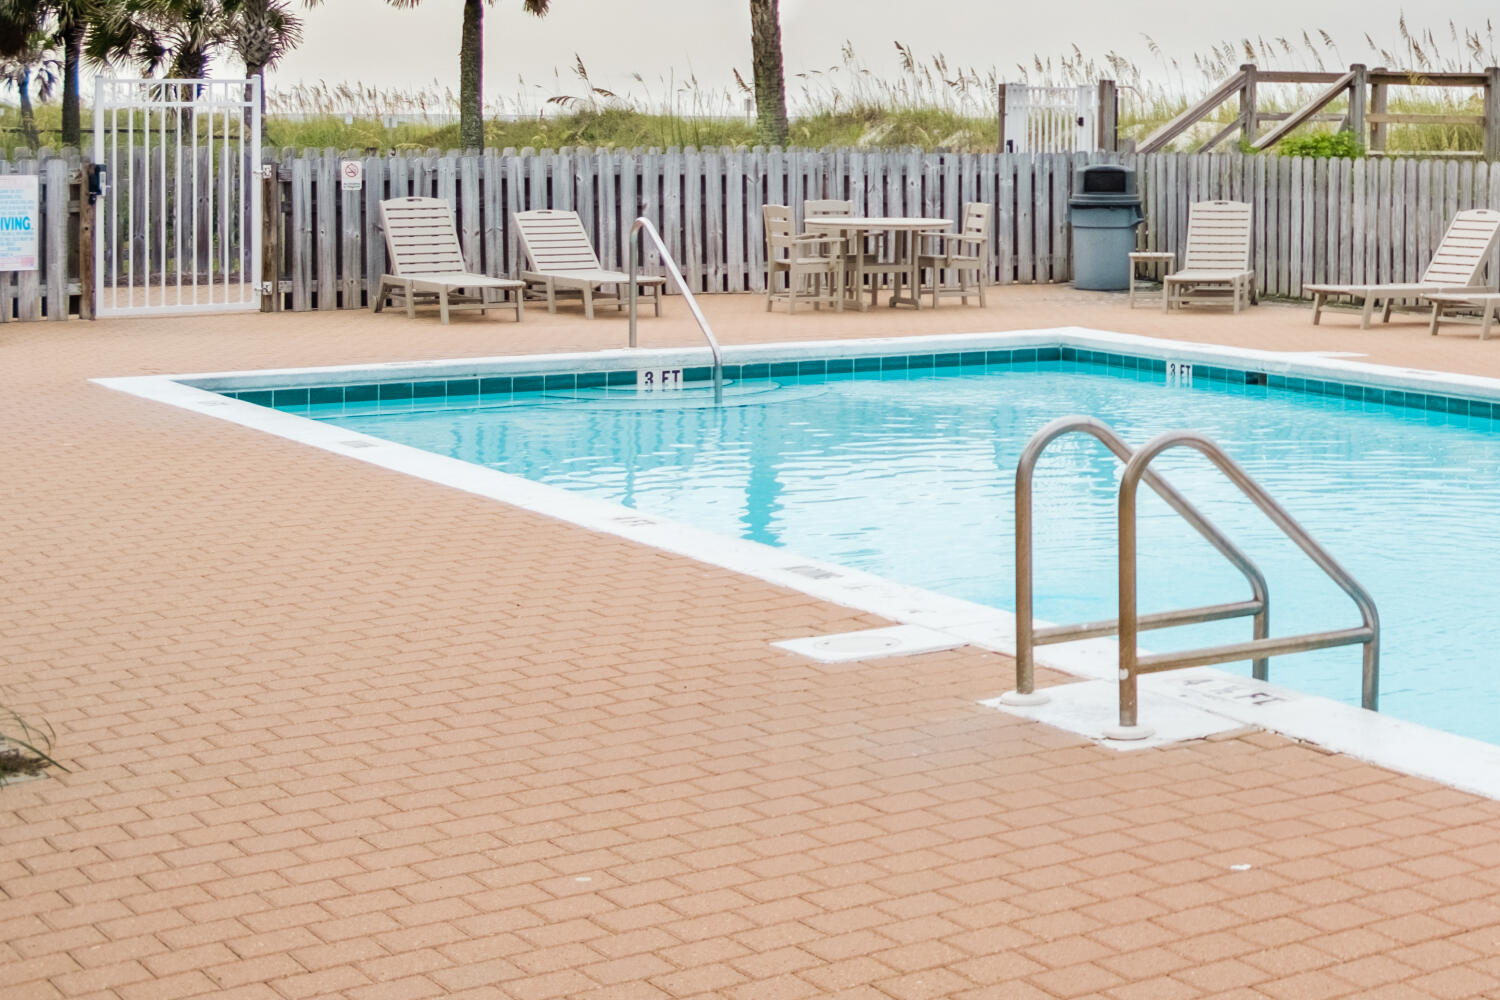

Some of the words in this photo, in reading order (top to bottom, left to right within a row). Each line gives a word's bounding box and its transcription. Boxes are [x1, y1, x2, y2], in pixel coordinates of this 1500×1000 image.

[644, 371, 654, 384] 3
[661, 369, 681, 383] FT
[1170, 363, 1176, 376] 3
[1179, 364, 1191, 376] FT
